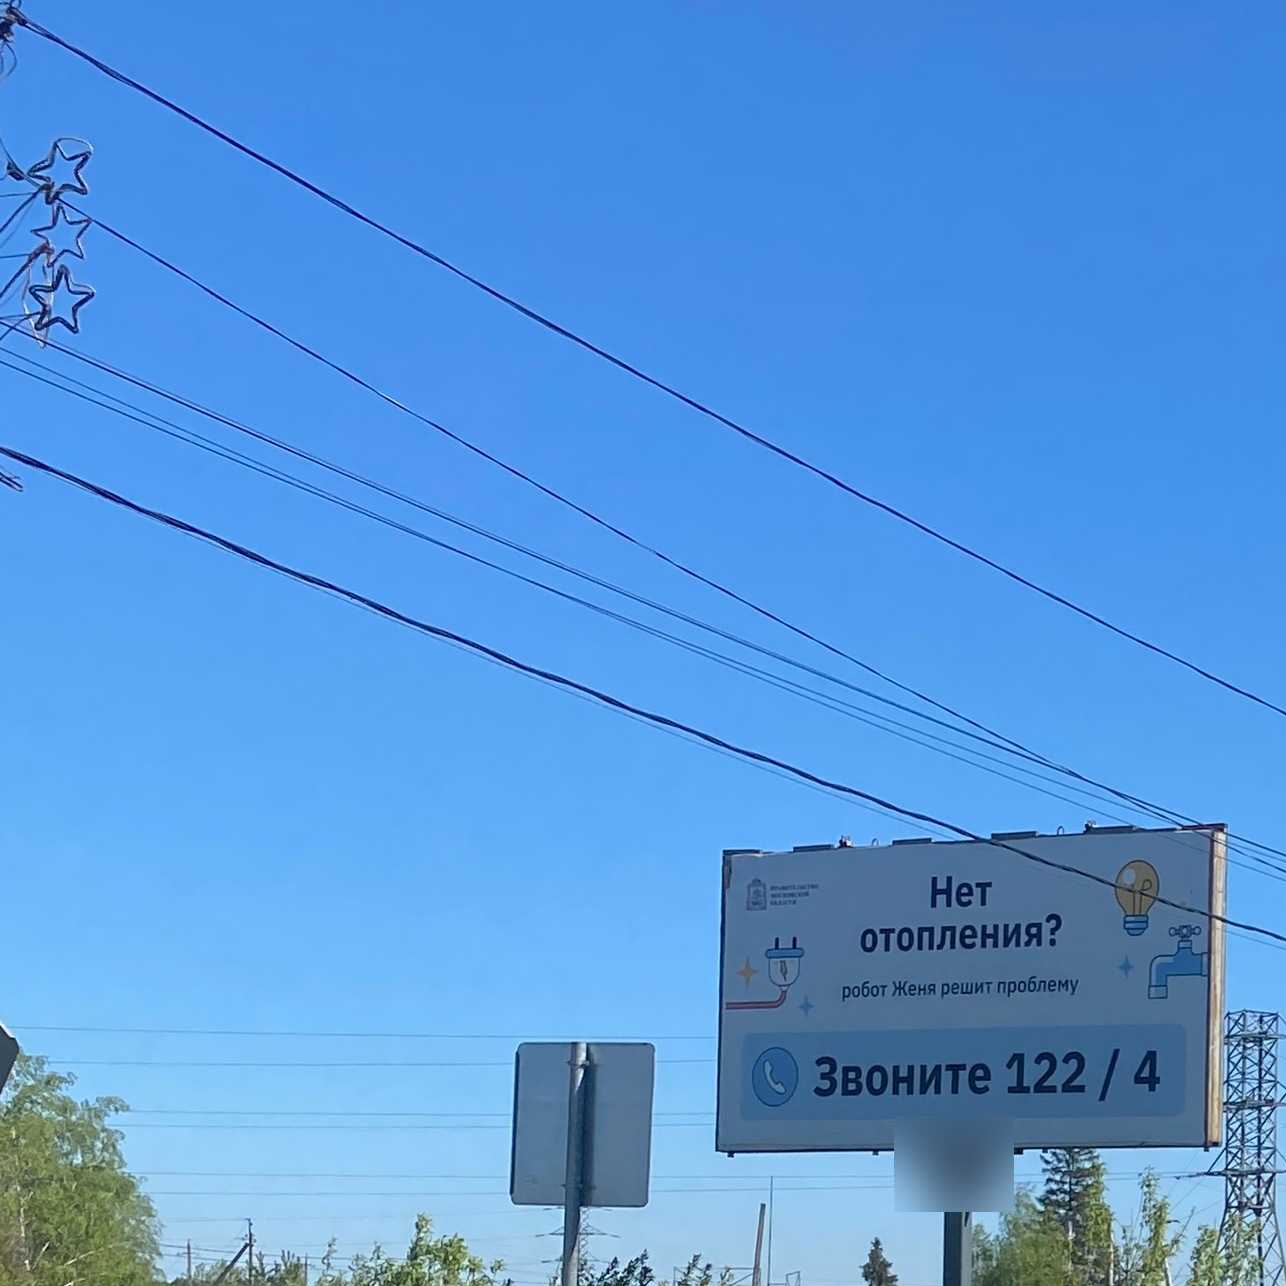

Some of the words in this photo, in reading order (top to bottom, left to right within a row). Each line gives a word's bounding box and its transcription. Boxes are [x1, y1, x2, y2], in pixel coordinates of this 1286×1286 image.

[930, 876, 992, 908] Нет
[860, 913, 1063, 952] отопления?
[842, 981, 888, 1001] робот
[891, 980, 936, 997] Женя
[940, 980, 993, 999] решит
[997, 976, 1079, 996] проблему
[813, 1056, 992, 1097] Звоните
[1005, 1051, 1086, 1094] 122
[1133, 1050, 1161, 1092] 4
